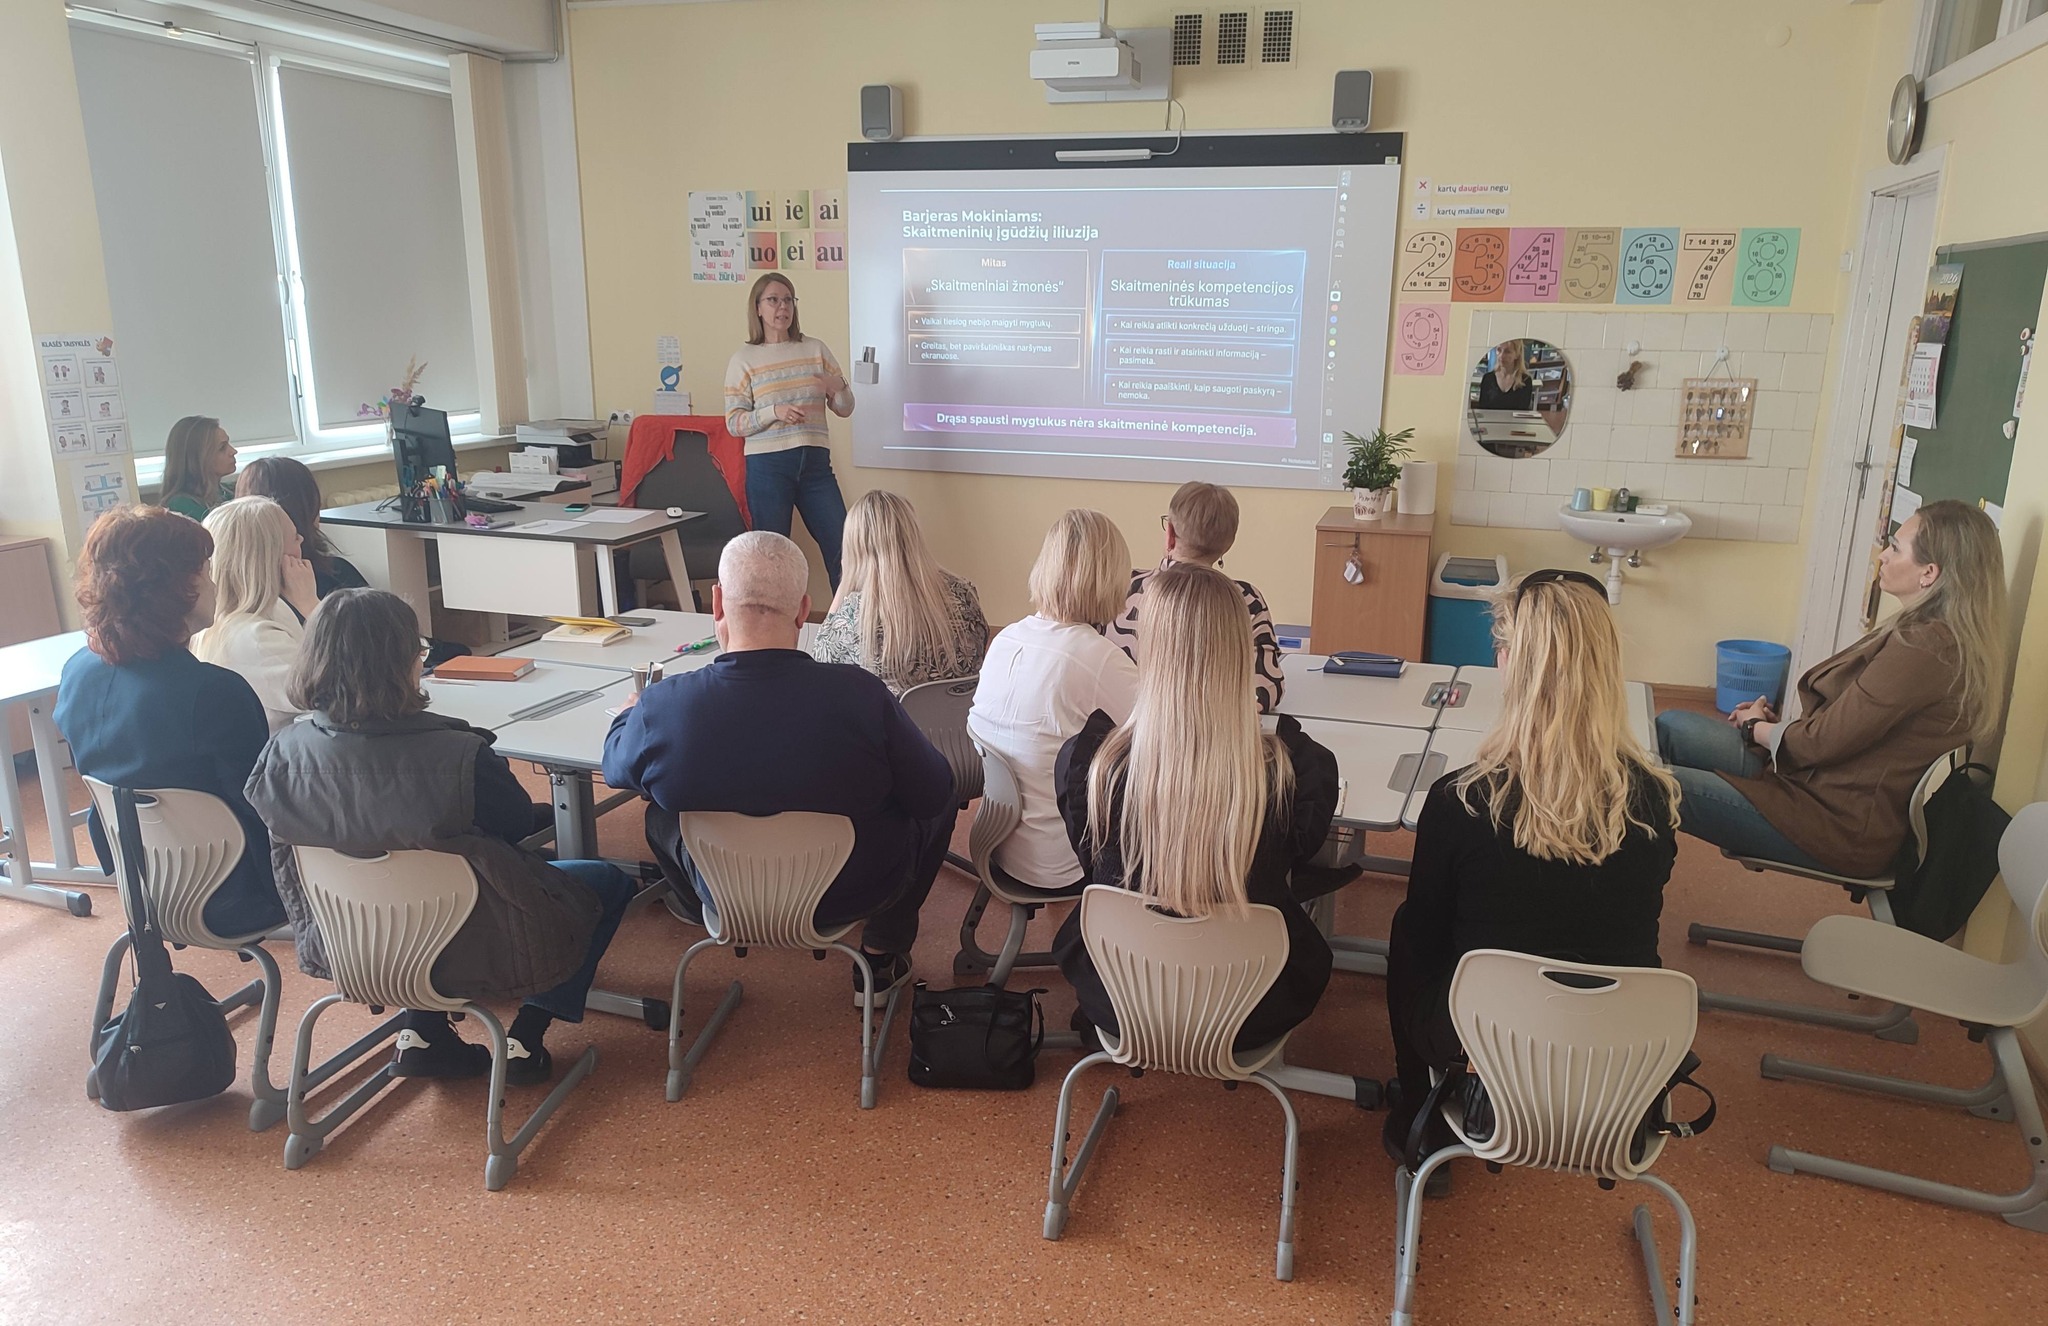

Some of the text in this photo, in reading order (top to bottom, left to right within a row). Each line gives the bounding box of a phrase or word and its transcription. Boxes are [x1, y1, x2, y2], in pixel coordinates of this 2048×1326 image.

[751, 199, 839, 221] ui ie ai
[903, 210, 1042, 224] Barjeras Mokiniams:
[903, 226, 1098, 241] Skaitmeninių įgūdžių iliuzija
[750, 240, 843, 262] uo ei au
[981, 258, 1007, 267] Mitas
[1194, 260, 1236, 270] situacija
[1111, 280, 1294, 296] Skaitmeninės kompetencijos
[1169, 295, 1230, 308] trūkumas
[968, 318, 990, 327] nebijo
[1156, 322, 1177, 330] atlikti
[1256, 324, 1287, 334] stringa.
[1133, 347, 1153, 355] reikia
[1119, 357, 1156, 365] pasimeta.
[1119, 381, 1131, 389] Kai
[1132, 382, 1152, 390] reikia
[1194, 384, 1210, 393] kaip
[1212, 385, 1241, 394] saugoti
[1118, 392, 1150, 400] nemoka.
[937, 413, 1257, 438] Drąsa spausti mygtukus nėra skaitmeninė kompetencija.
